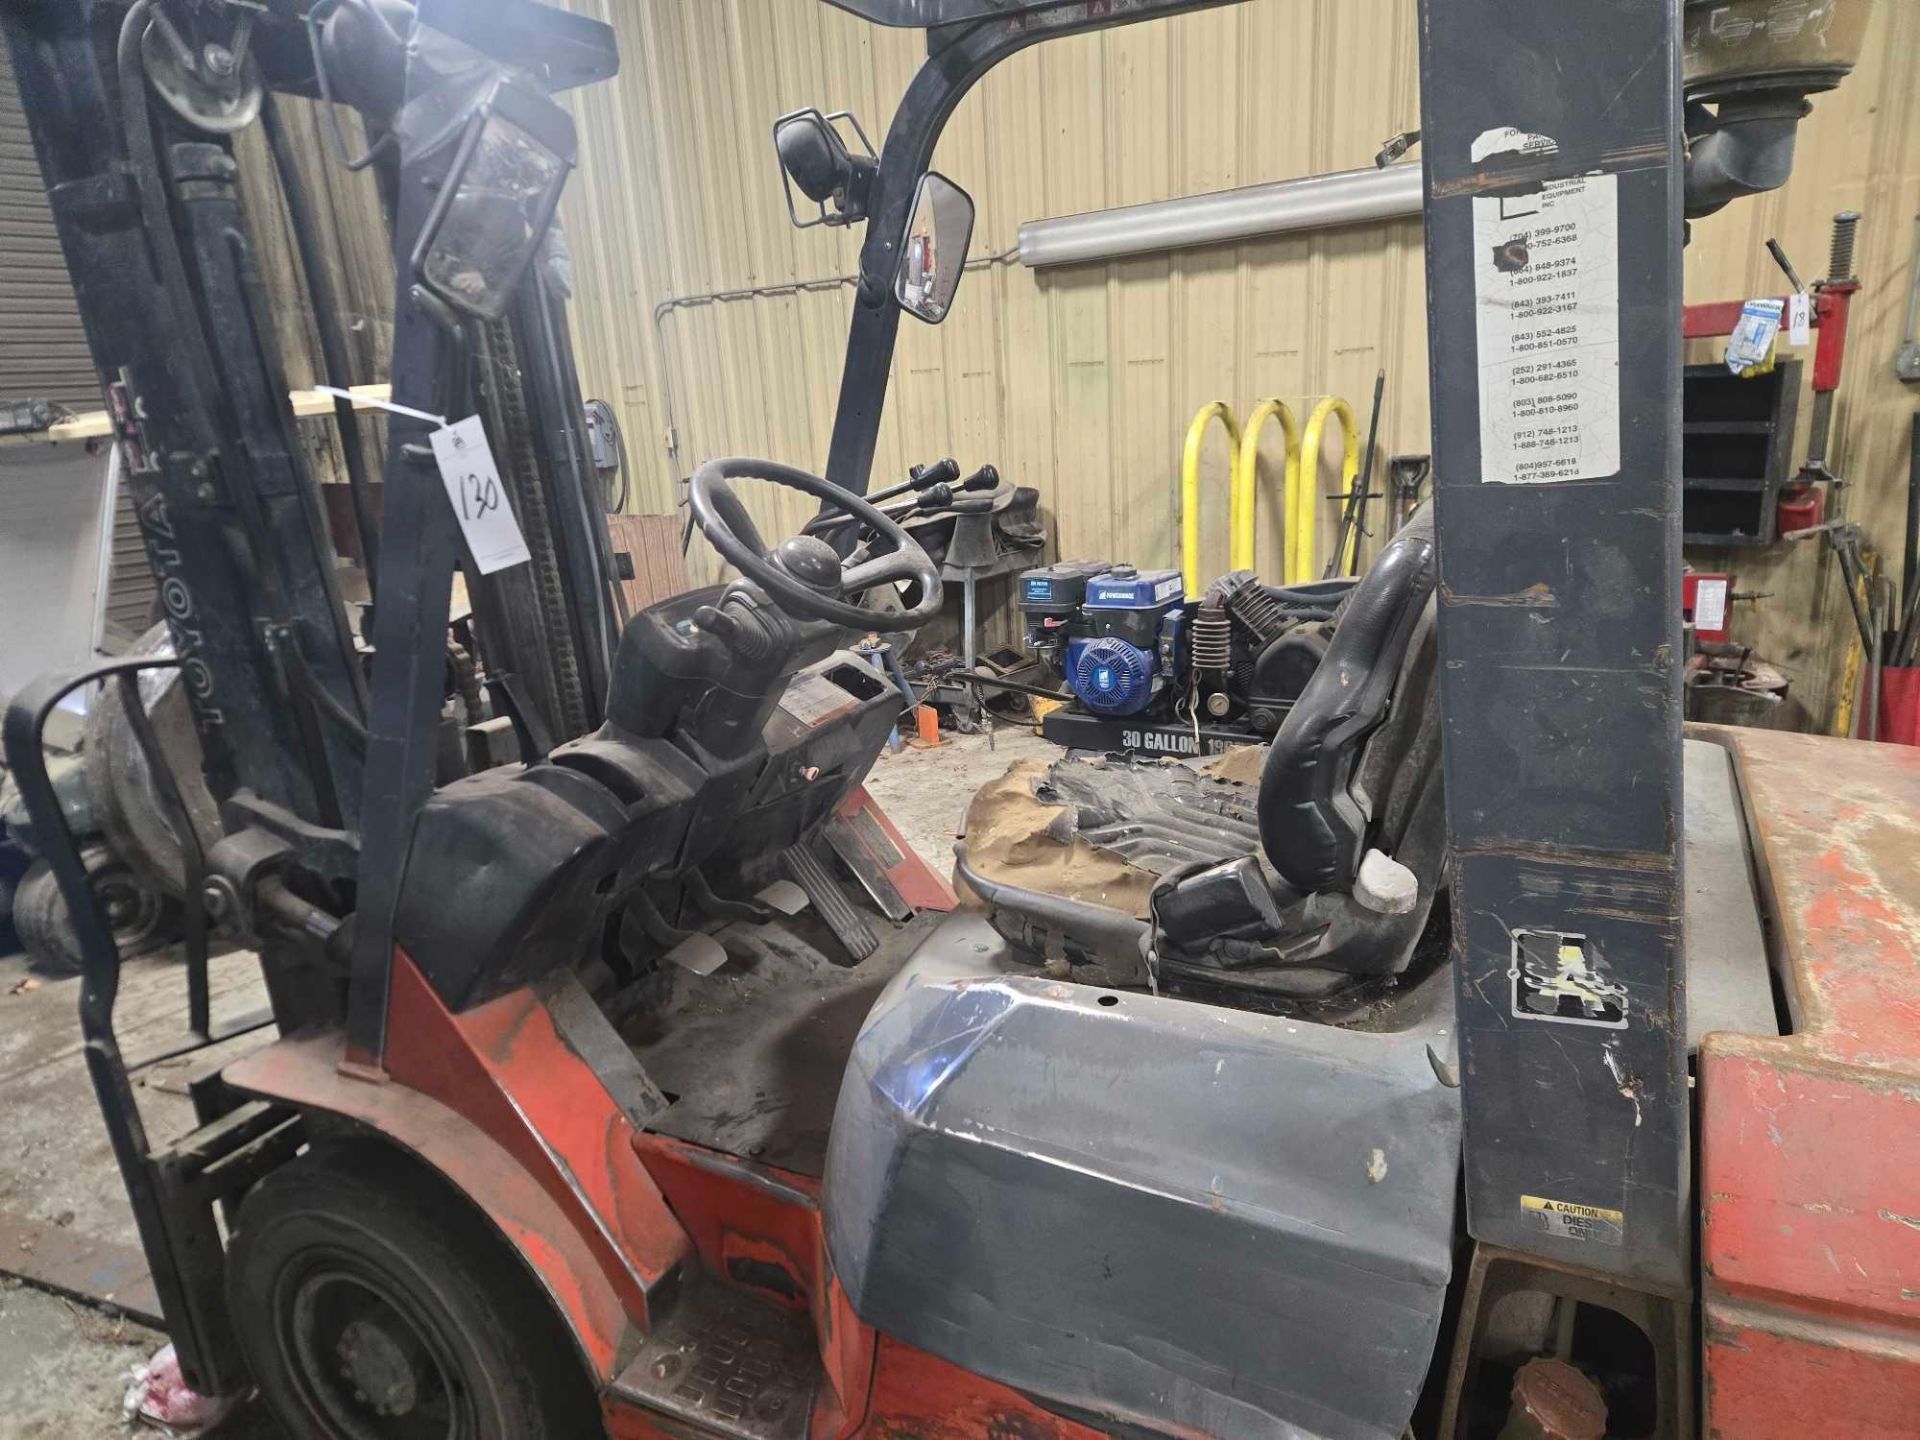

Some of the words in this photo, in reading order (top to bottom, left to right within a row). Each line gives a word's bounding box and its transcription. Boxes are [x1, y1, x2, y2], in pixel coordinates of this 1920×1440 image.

[1541, 186, 1586, 201] EQUIPMENT
[1535, 222, 1576, 238] 399-9700
[1512, 364, 1534, 376] (252)
[459, 473, 499, 521] 130
[1122, 730, 1141, 748] 30
[1143, 732, 1200, 754] GALLON
[1556, 1203, 1598, 1218] CAUTION
